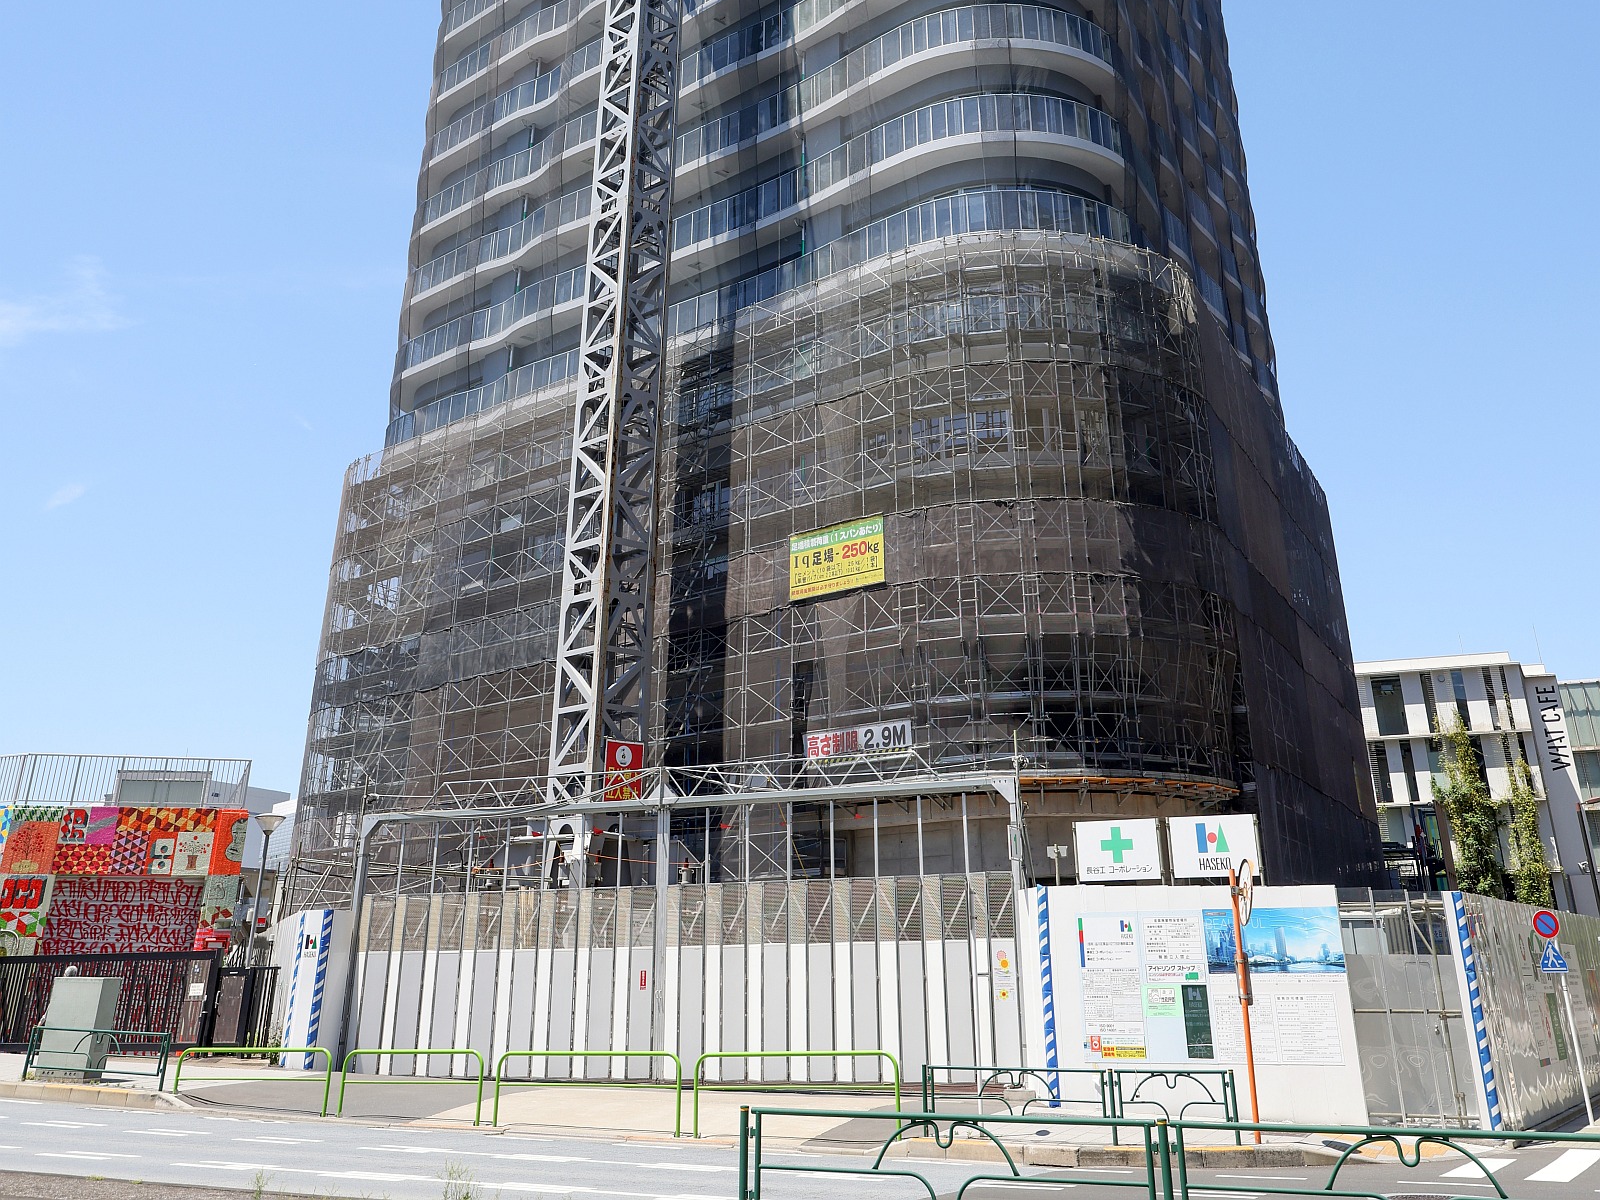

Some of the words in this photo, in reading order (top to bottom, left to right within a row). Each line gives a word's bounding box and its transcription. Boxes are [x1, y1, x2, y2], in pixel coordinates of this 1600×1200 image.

[1535, 685, 1561, 722] CAFE
[807, 730, 858, 759] 高さ制限
[863, 723, 907, 750] 2.9M
[1544, 728, 1571, 771] WHAT
[1086, 866, 1106, 875] 長谷工
[1108, 864, 1153, 874] コーポレーション
[1198, 857, 1232, 871] HASEKO
